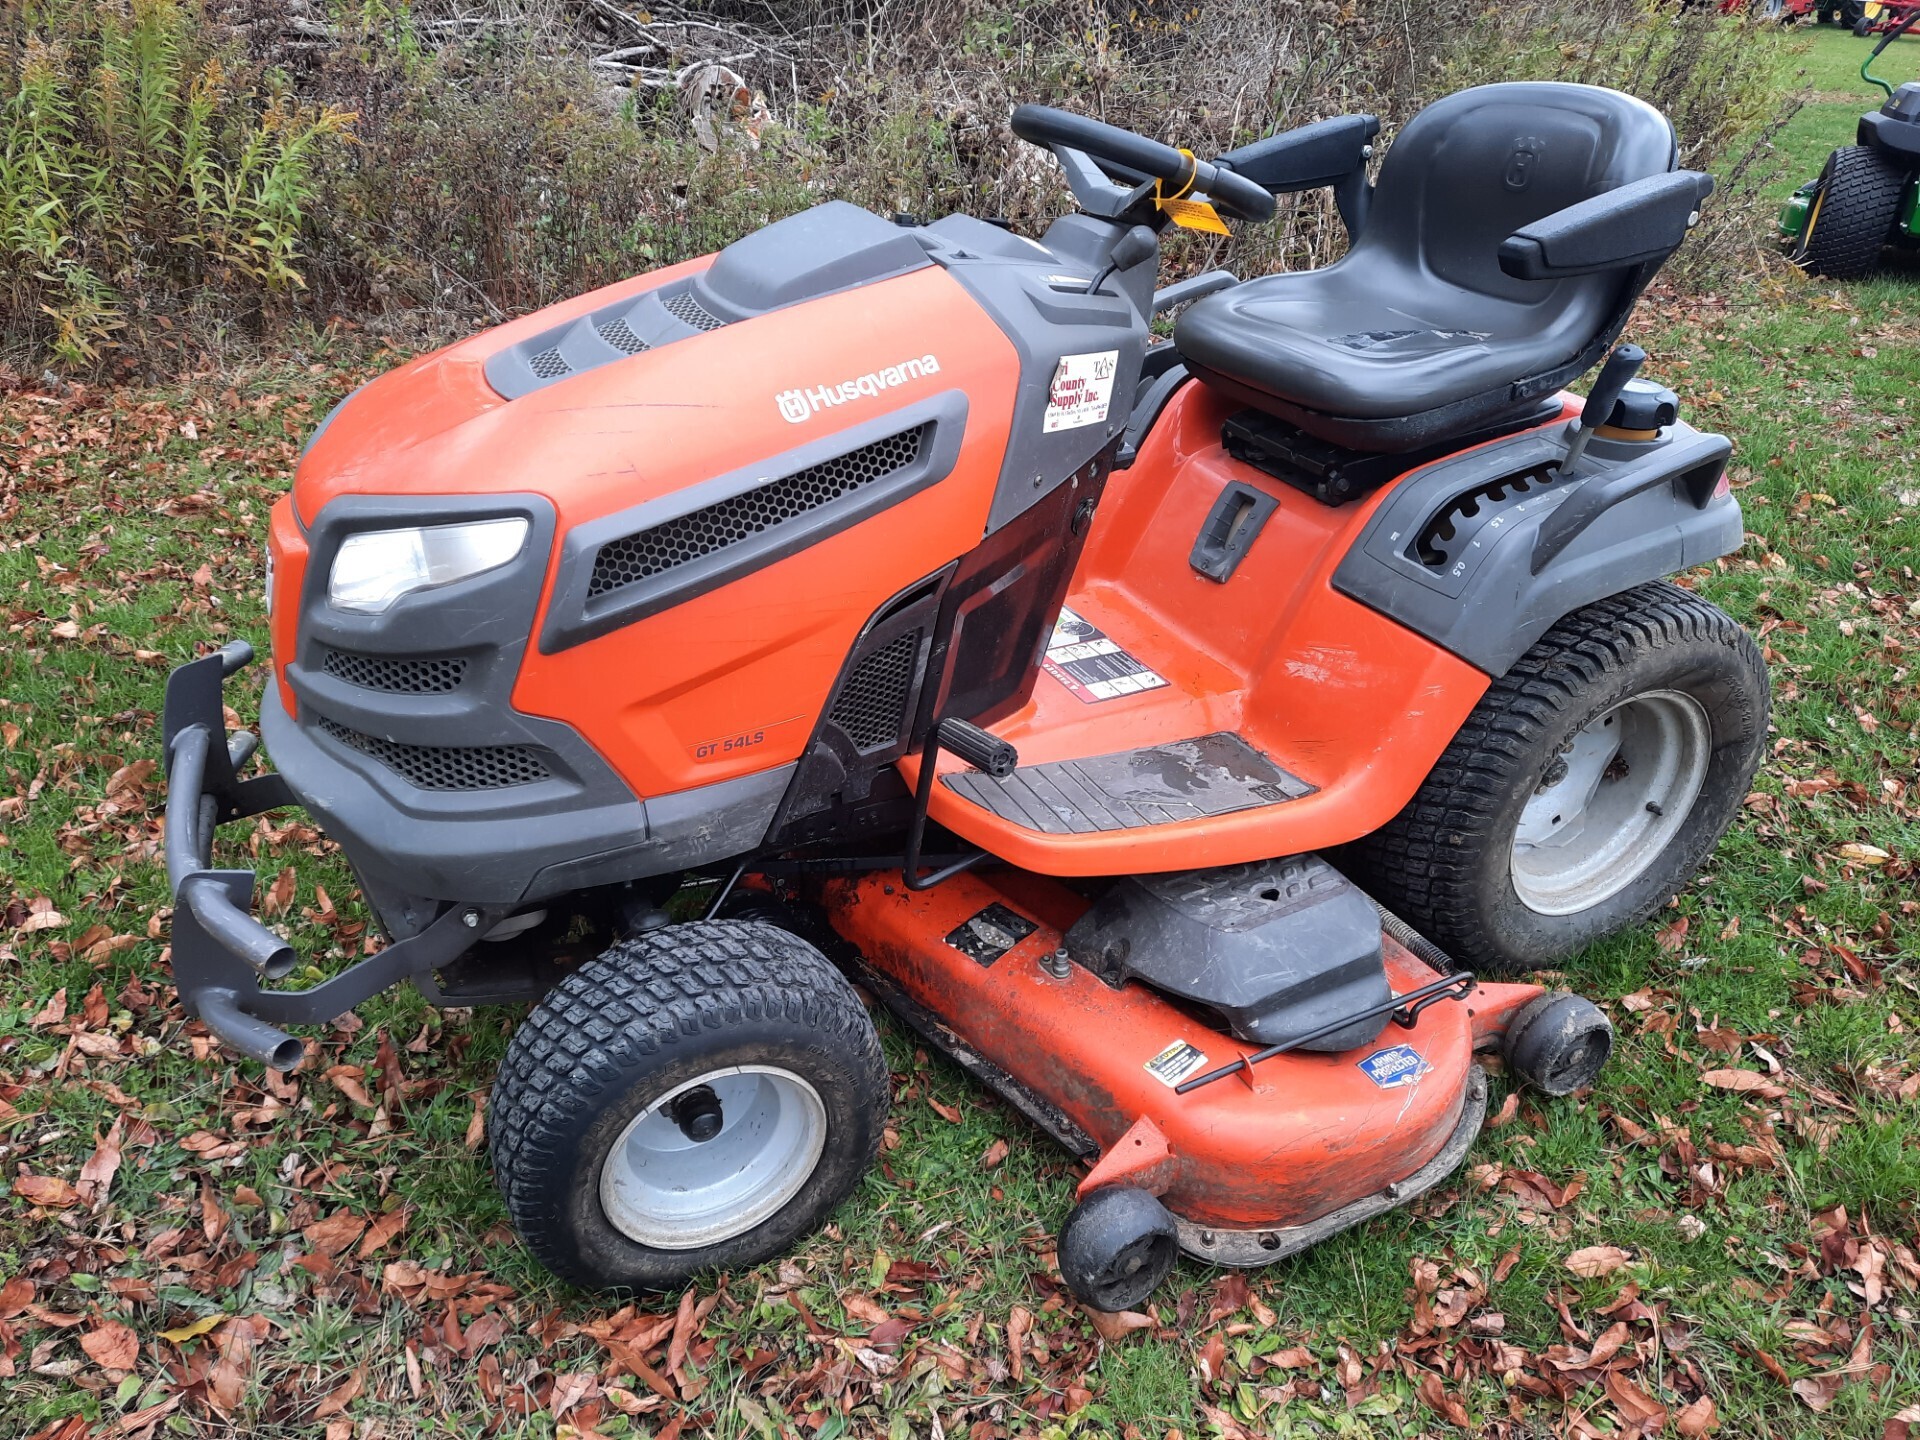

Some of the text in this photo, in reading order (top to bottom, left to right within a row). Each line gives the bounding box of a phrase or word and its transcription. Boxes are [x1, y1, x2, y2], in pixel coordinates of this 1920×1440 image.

[805, 354, 940, 411] Husqvarna
[1052, 376, 1087, 393] County
[1050, 390, 1083, 410] Supply
[1084, 389, 1099, 403] Inc.
[1515, 504, 1526, 512] 2
[1472, 538, 1481, 549] 1
[1452, 560, 1466, 578] 0.5
[696, 731, 764, 758] GT 54LS
[1371, 1051, 1403, 1068] ARMOR
[1371, 1055, 1418, 1080] PROTECTED
